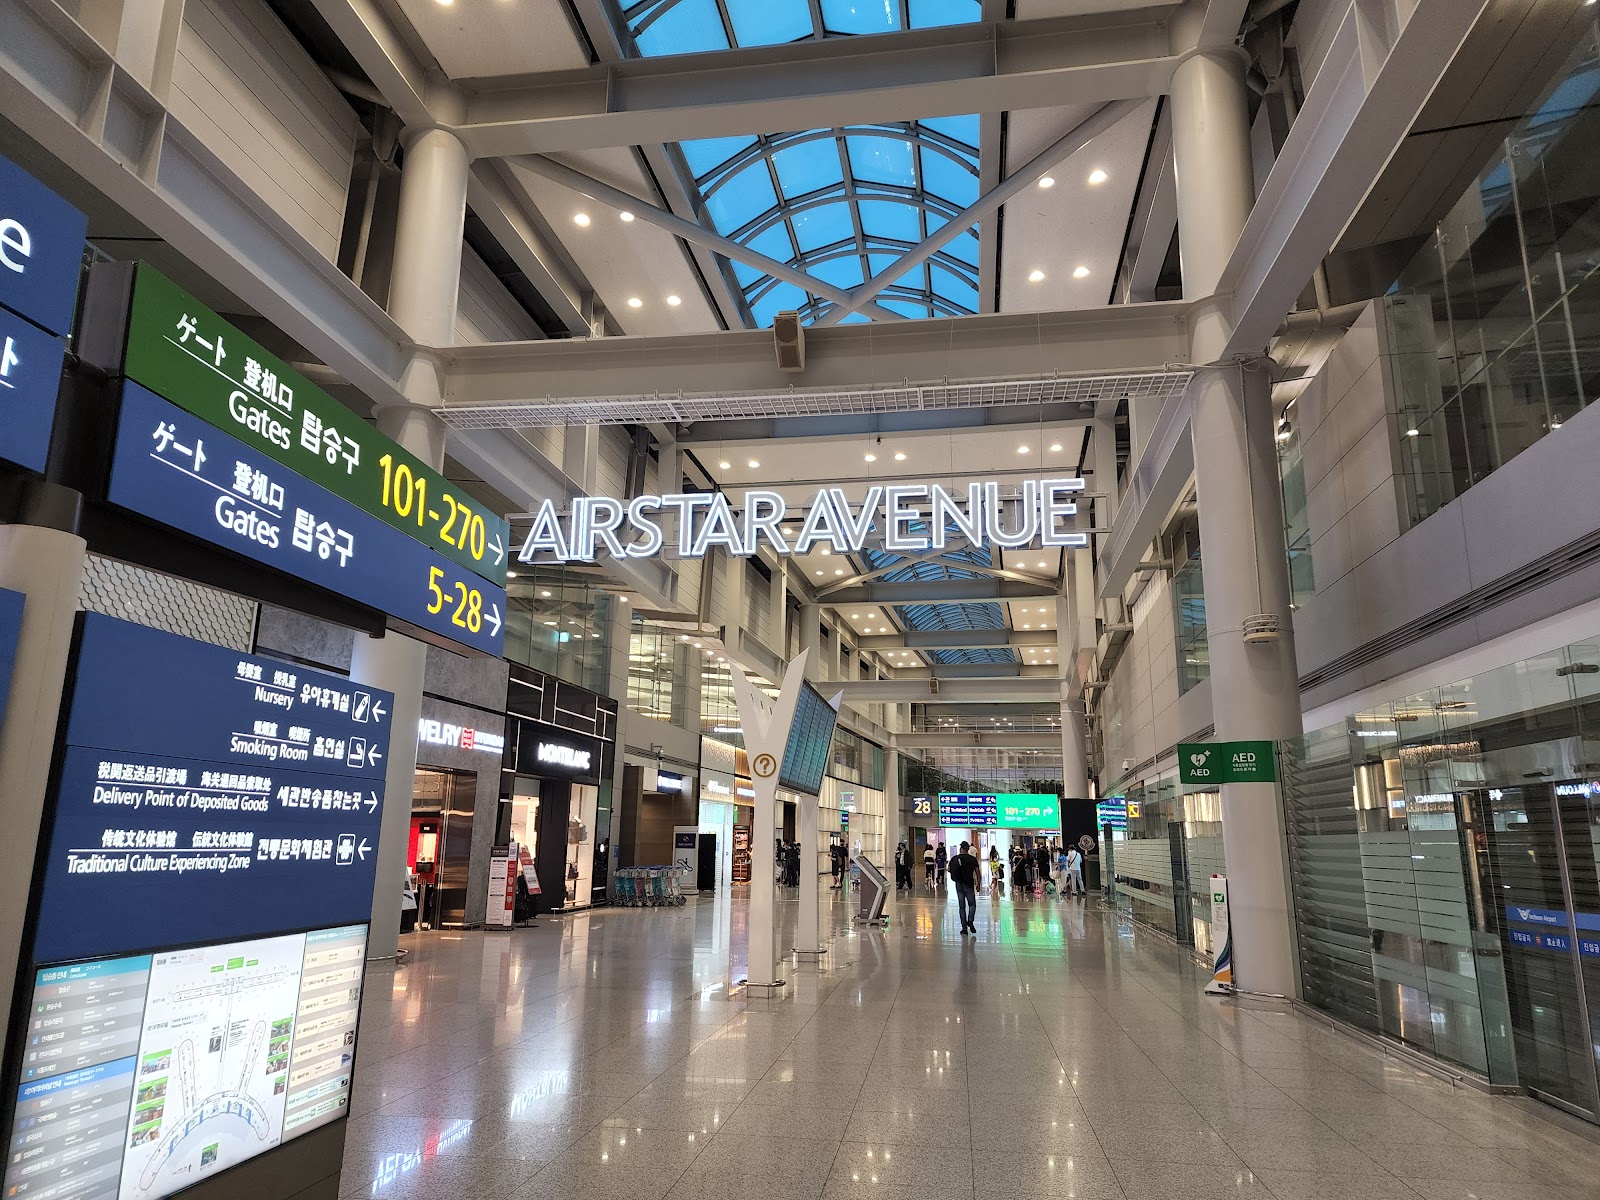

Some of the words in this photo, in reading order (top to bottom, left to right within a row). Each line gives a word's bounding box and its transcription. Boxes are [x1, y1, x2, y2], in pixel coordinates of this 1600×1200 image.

[175, 312, 228, 369] ゲート
[244, 356, 293, 412] 登机口
[228, 390, 291, 451] Gates
[300, 409, 360, 475] 탑승구
[152, 420, 207, 472] ゲート
[232, 460, 285, 511] 登机口
[215, 495, 280, 549] Gates
[378, 454, 486, 562] 101-270
[518, 491, 791, 563] AIRSTAR
[794, 477, 1088, 552] AVENUE
[292, 508, 354, 568] 탑승구
[426, 565, 483, 633] 5-28
[254, 685, 294, 711] Nursery
[300, 684, 350, 712] 유아휴게실
[230, 737, 277, 760] Smoking
[279, 743, 308, 761] Room
[313, 736, 345, 760] 흡연실
[537, 742, 592, 771] MONTBLANC
[1232, 752, 1256, 763] AED
[1190, 768, 1210, 776] AED
[93, 786, 143, 810] Delivery
[144, 789, 174, 807] Point
[176, 791, 190, 808] of
[190, 793, 239, 813] Deposited
[240, 796, 269, 812] Goods
[914, 801, 931, 814] 28
[67, 853, 129, 874] Traditional
[129, 854, 168, 873] Culture
[169, 854, 228, 875] Experiencing
[227, 853, 250, 870] Zone
